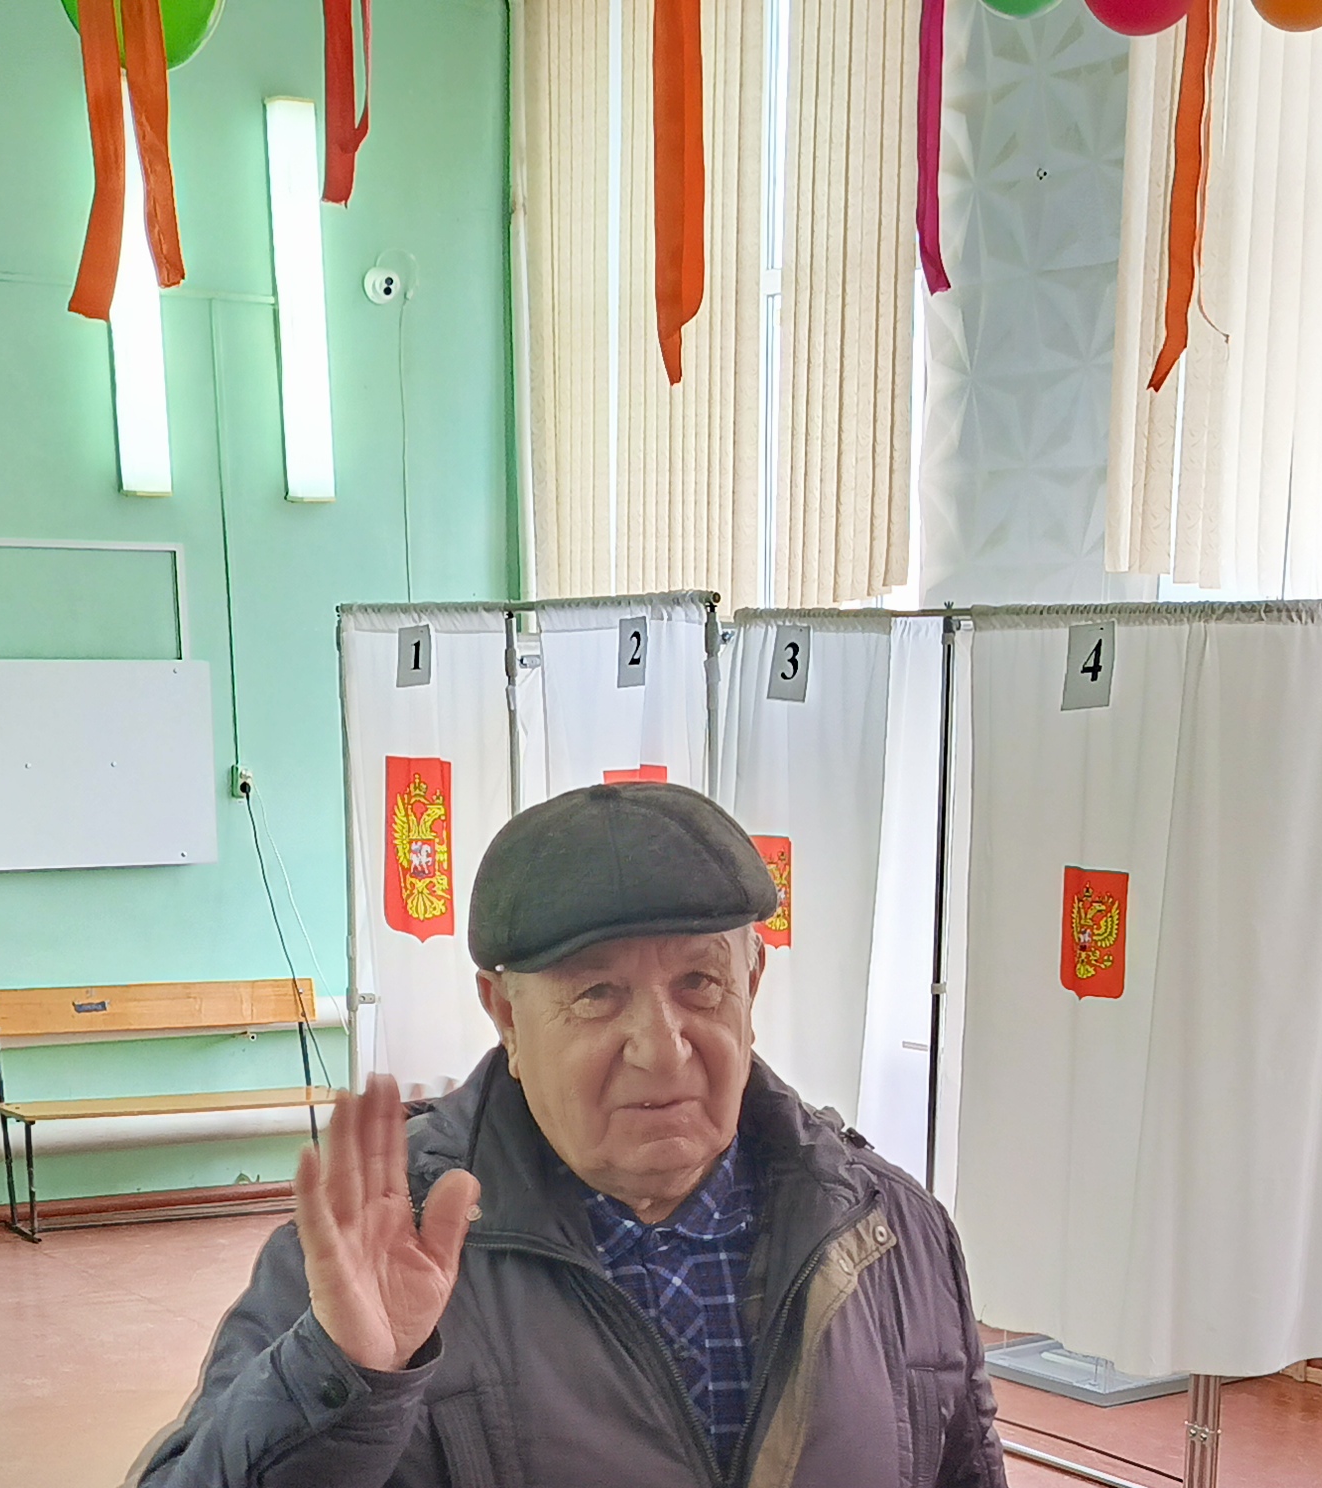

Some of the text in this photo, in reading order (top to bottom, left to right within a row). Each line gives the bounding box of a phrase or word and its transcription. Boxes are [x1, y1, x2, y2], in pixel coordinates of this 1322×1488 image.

[410, 640, 421, 670] 1
[628, 631, 642, 665] 2
[780, 642, 800, 680] 3
[1080, 638, 1103, 682] 4
